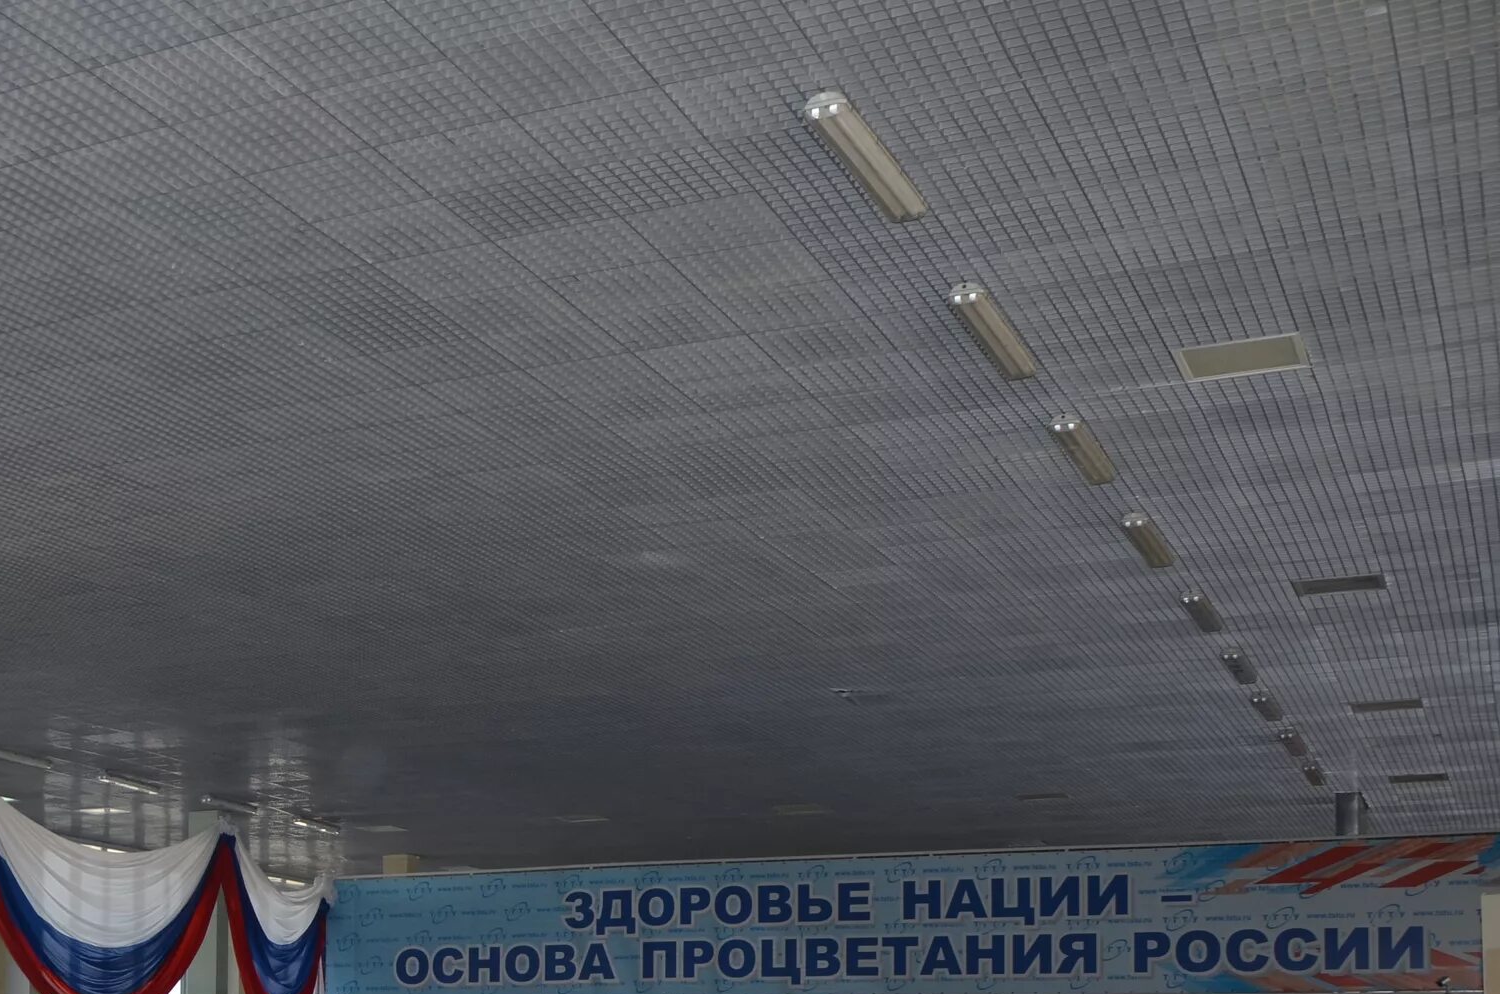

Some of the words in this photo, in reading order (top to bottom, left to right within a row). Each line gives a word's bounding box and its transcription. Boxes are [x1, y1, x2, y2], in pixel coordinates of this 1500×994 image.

[565, 882, 871, 935] ЗДОРОВЬЕ
[903, 874, 1128, 926] НАЦИИ
[396, 943, 615, 985] ОСНОВА
[643, 933, 1097, 985] ПРОЦВЕТАНИЯ
[1134, 926, 1424, 973] РОССИИ
